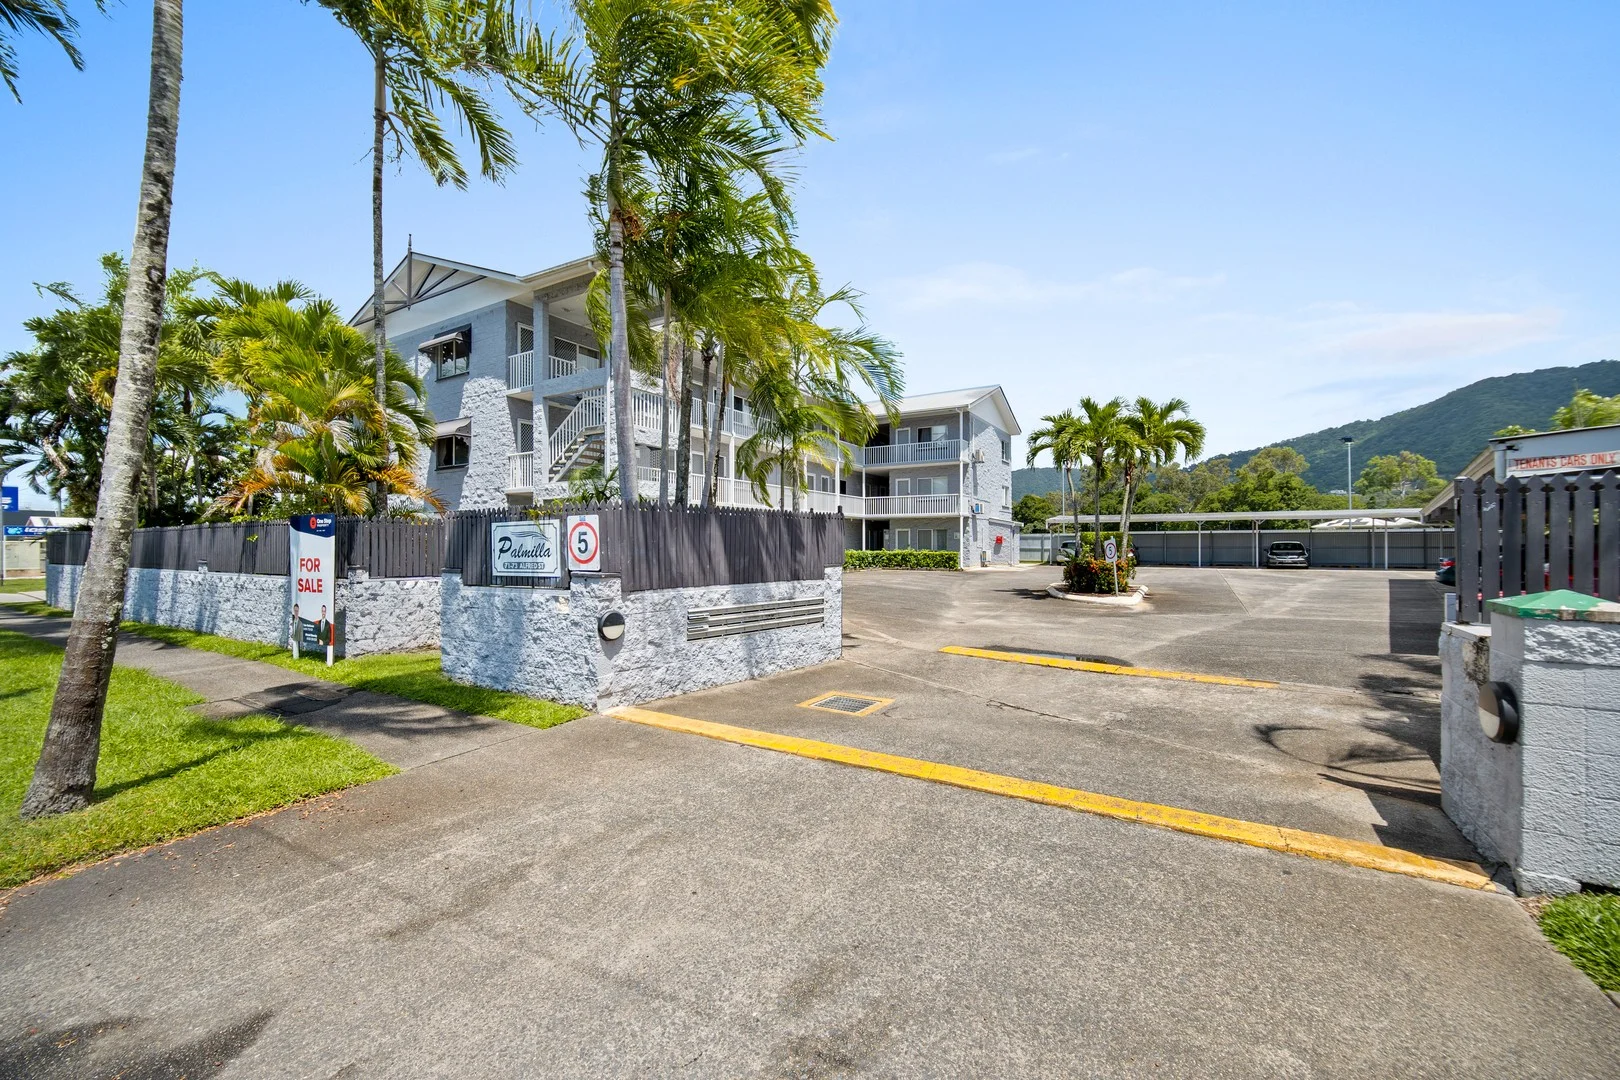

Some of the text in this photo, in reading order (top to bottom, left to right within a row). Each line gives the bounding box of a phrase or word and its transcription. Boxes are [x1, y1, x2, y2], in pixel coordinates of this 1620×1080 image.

[1514, 452, 1617, 470] TENANTS CARS ONLY
[497, 536, 552, 560] Palmilla
[577, 531, 589, 554] 5
[1108, 546, 1113, 556] 5
[299, 557, 321, 573] FOR
[519, 562, 538, 570] ALFRED
[538, 562, 544, 570] ST
[297, 578, 323, 593] SALE
